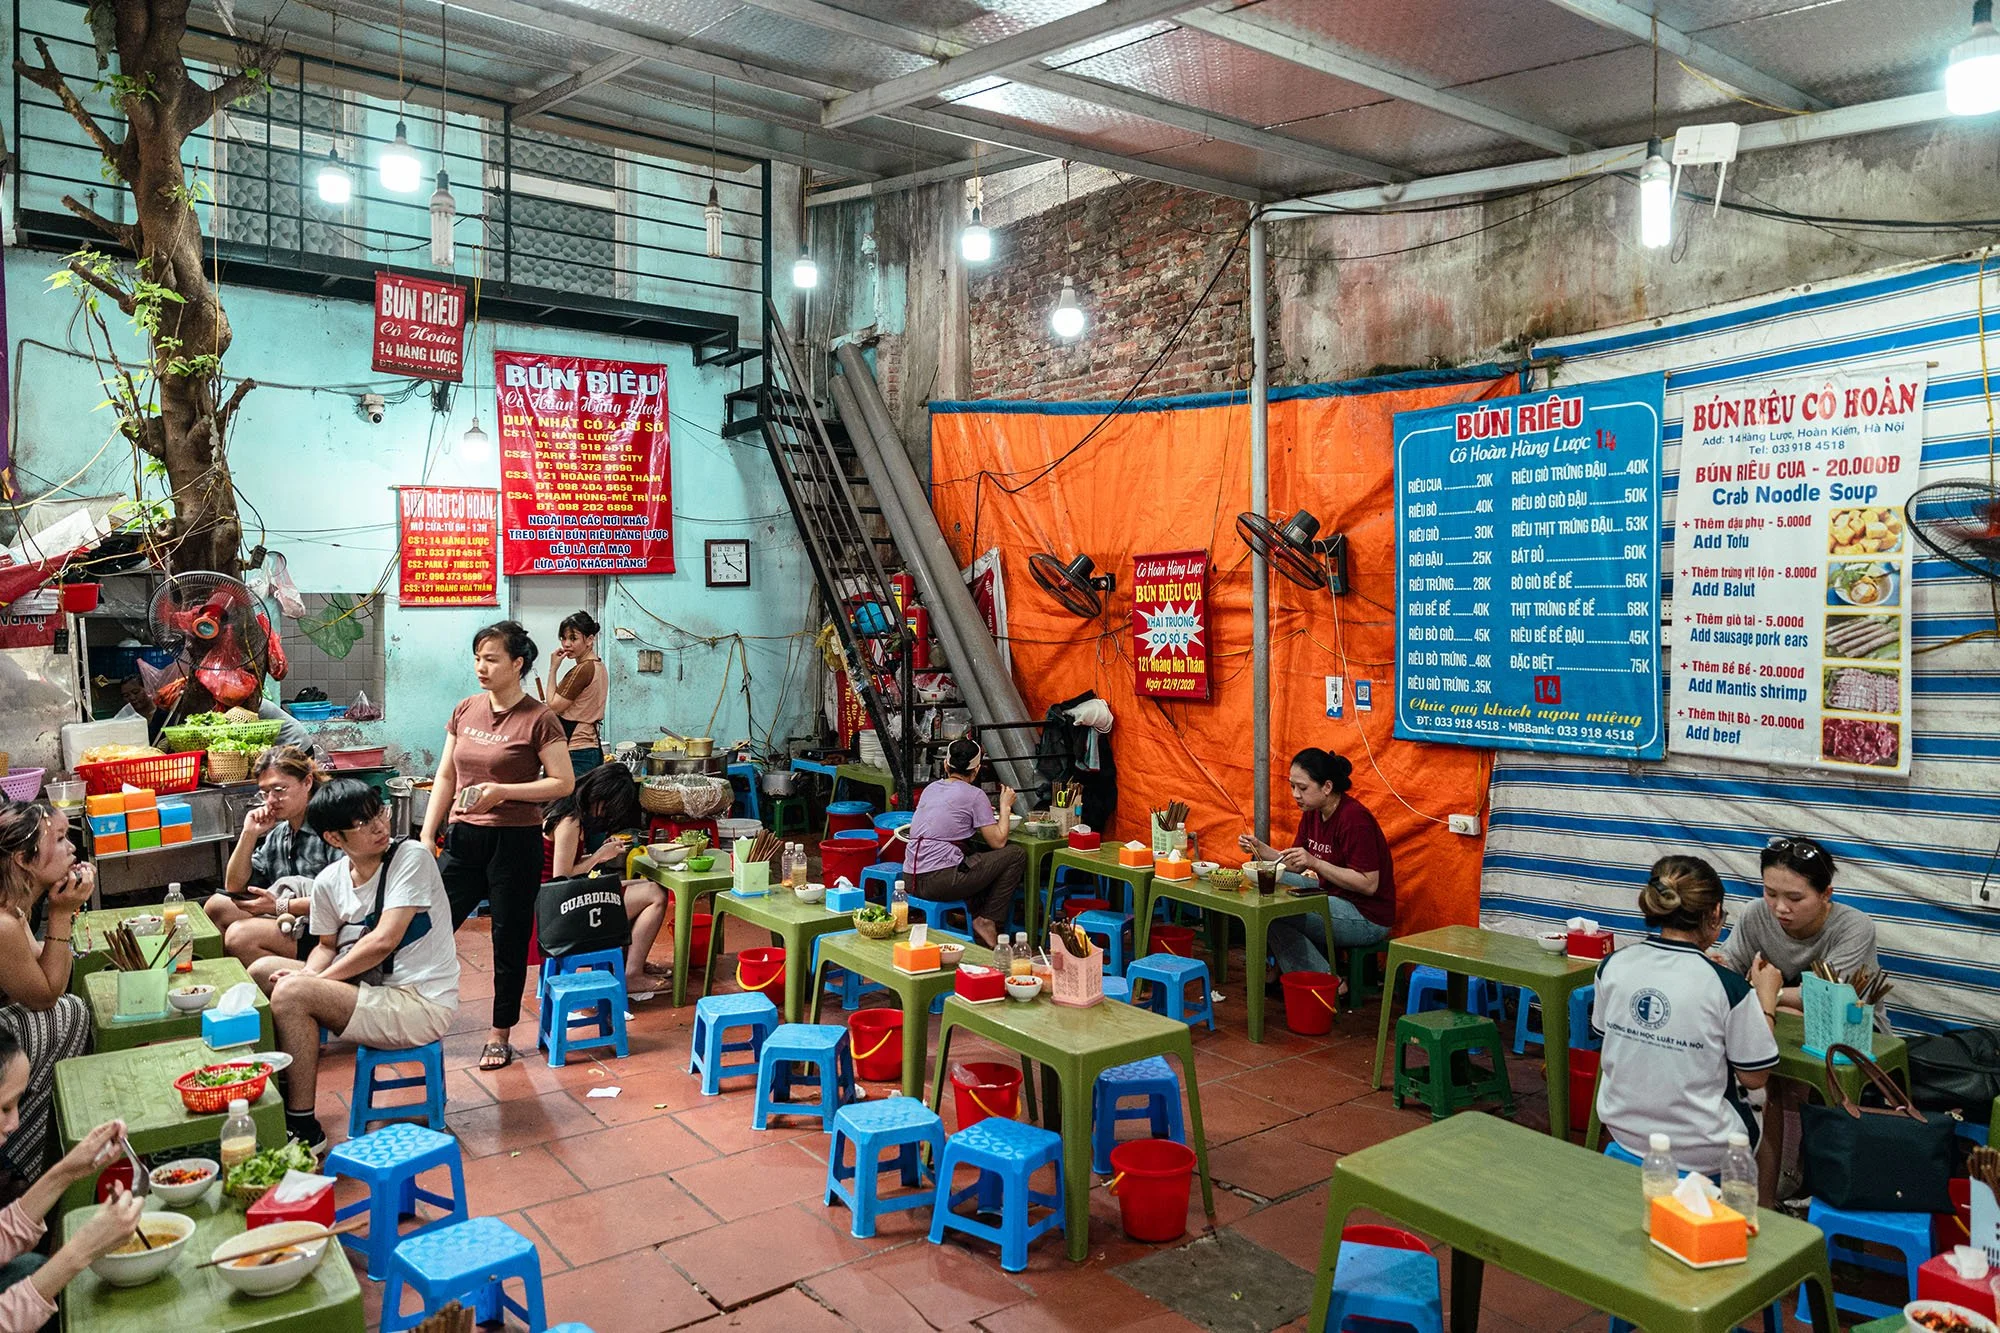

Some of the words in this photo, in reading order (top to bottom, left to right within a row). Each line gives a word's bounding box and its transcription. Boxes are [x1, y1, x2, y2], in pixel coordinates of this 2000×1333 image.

[382, 280, 417, 321] BÚN
[422, 287, 459, 327] RIÊU
[380, 321, 401, 337] Cô
[409, 325, 457, 345] Hoàn
[379, 341, 393, 356] 14
[396, 343, 427, 361] HÀNG
[430, 349, 458, 367] LƯỢC
[505, 362, 576, 391] BÚN
[1692, 393, 1741, 432] BÚN
[1743, 389, 1797, 426] RIÊU
[1802, 382, 1837, 421] CÔ
[503, 415, 534, 426] DUY
[539, 414, 579, 429] NHẤT
[584, 417, 603, 430] CÓ
[608, 420, 617, 430] 4
[1456, 404, 1512, 442] BÚN
[1517, 394, 1584, 435] RIÊU
[504, 430, 532, 438] CS1:
[535, 431, 549, 439] 14
[552, 430, 585, 441] HÀNG
[588, 432, 617, 443] LƯỢC
[504, 450, 532, 458] CS2:
[535, 452, 566, 460] PARK
[620, 454, 643, 462] CITY
[1450, 446, 1468, 464] Cô
[1470, 443, 1507, 463] Hoàn
[1510, 439, 1550, 459] Hàng
[1553, 436, 1591, 454] Lược
[1749, 445, 1769, 455] Tel:
[1772, 443, 1791, 454] 033
[1792, 442, 1811, 453] 918
[1814, 440, 1846, 451] 4518
[1512, 468, 1533, 485] RIÊU
[1535, 465, 1549, 483] GIÒ
[1550, 463, 1584, 481] TRỨNG
[1585, 460, 1607, 480] ĐẬU
[1695, 462, 1732, 483] BÚN
[1736, 460, 1771, 481] RIÊU
[1776, 460, 1806, 479] CUA
[1826, 455, 1901, 477] 20.000Đ
[1408, 477, 1426, 494] RIÊU
[1427, 477, 1443, 492] CUA
[1712, 486, 1748, 505] Crab
[1755, 483, 1820, 503] Noodle
[1829, 482, 1878, 505] Soup
[426, 489, 450, 518] RIÊU
[451, 489, 465, 518] CÔ
[467, 491, 493, 519] HOÀN
[537, 503, 554, 511] ĐT:
[582, 503, 604, 511] 202
[1512, 493, 1533, 511] RIÊU
[1534, 492, 1547, 509] BÒ
[1548, 491, 1565, 509] GIÒ
[1568, 489, 1588, 509] ĐẬU
[528, 514, 561, 526] NGOÀI
[564, 515, 578, 525] RA
[580, 514, 601, 525] CÁC
[603, 515, 621, 525] NƠI
[622, 515, 649, 525] KHÁC
[1512, 520, 1533, 538] RIÊU
[1534, 521, 1556, 538] THỊT
[1557, 517, 1589, 535] TRỨNG
[1625, 516, 1649, 531] 53K
[1694, 517, 1724, 529] Thêm
[1728, 516, 1743, 531] đậu
[1745, 516, 1765, 530] phụ
[1777, 515, 1812, 528] 5.000đ
[508, 530, 535, 540] TREO
[565, 528, 587, 540] BÚN
[589, 528, 612, 540] RIÊU
[615, 528, 641, 540] HÀNG
[643, 530, 668, 542] LƯỢC
[1408, 528, 1426, 543] RIÊU
[1426, 526, 1440, 541] GIÒ
[1474, 525, 1493, 539] 30K
[1693, 534, 1722, 549] Add
[1726, 534, 1749, 549] Tofu
[574, 542, 587, 554] LÀ
[608, 545, 631, 556] MẠO
[535, 558, 554, 569] LỪA
[580, 557, 614, 568] KHÁCH
[616, 557, 647, 568] HÀNG!
[1136, 562, 1147, 578] Cô
[1147, 561, 1166, 578] Hoàn
[1167, 559, 1186, 580] Hàng
[1135, 580, 1157, 603] BÚN
[1159, 578, 1182, 602] RIÊU
[1184, 582, 1202, 601] CUA
[1692, 582, 1719, 596] Add
[1724, 582, 1755, 597] Balut
[1696, 613, 1723, 625] Thêm
[1726, 614, 1742, 627] giò
[1744, 615, 1756, 626] tai
[1766, 615, 1804, 628] 5.000đ
[1152, 632, 1167, 644] CƠ
[1169, 629, 1181, 644] SỞ
[1182, 633, 1189, 644] 5
[1408, 625, 1424, 641] RIÊU
[1426, 625, 1438, 641] BÒ
[1474, 628, 1490, 642] 45K
[1690, 628, 1711, 642] Add
[1713, 630, 1754, 646] sausage
[1755, 631, 1781, 647] pork
[1784, 634, 1808, 648] ears
[1138, 656, 1149, 672] 121
[1150, 655, 1171, 674] Hoàng
[1172, 656, 1185, 672] Hoa
[1186, 655, 1205, 673] Thám
[1510, 653, 1530, 672] ĐẶC
[1532, 653, 1555, 672] BIỆT
[1688, 677, 1713, 693] Add
[1716, 679, 1757, 697] Mantis
[1760, 683, 1808, 703] shrimp
[1416, 716, 1432, 726] ĐT:
[1434, 717, 1452, 728] 033
[1454, 718, 1473, 729] 918
[1474, 719, 1499, 731] 4518
[1508, 722, 1555, 735] MBBank:
[1557, 725, 1578, 737] 033
[1580, 727, 1602, 739] 918
[1604, 729, 1634, 741] 4518
[1688, 707, 1715, 721] Thêm
[1718, 710, 1735, 725] thịt
[1737, 711, 1751, 725] Bò
[1761, 714, 1805, 730] 20.000đ
[1686, 725, 1710, 741] Add
[1713, 728, 1742, 744] beef
[560, 891, 621, 915] GUARDIANS
[589, 907, 602, 928] C
